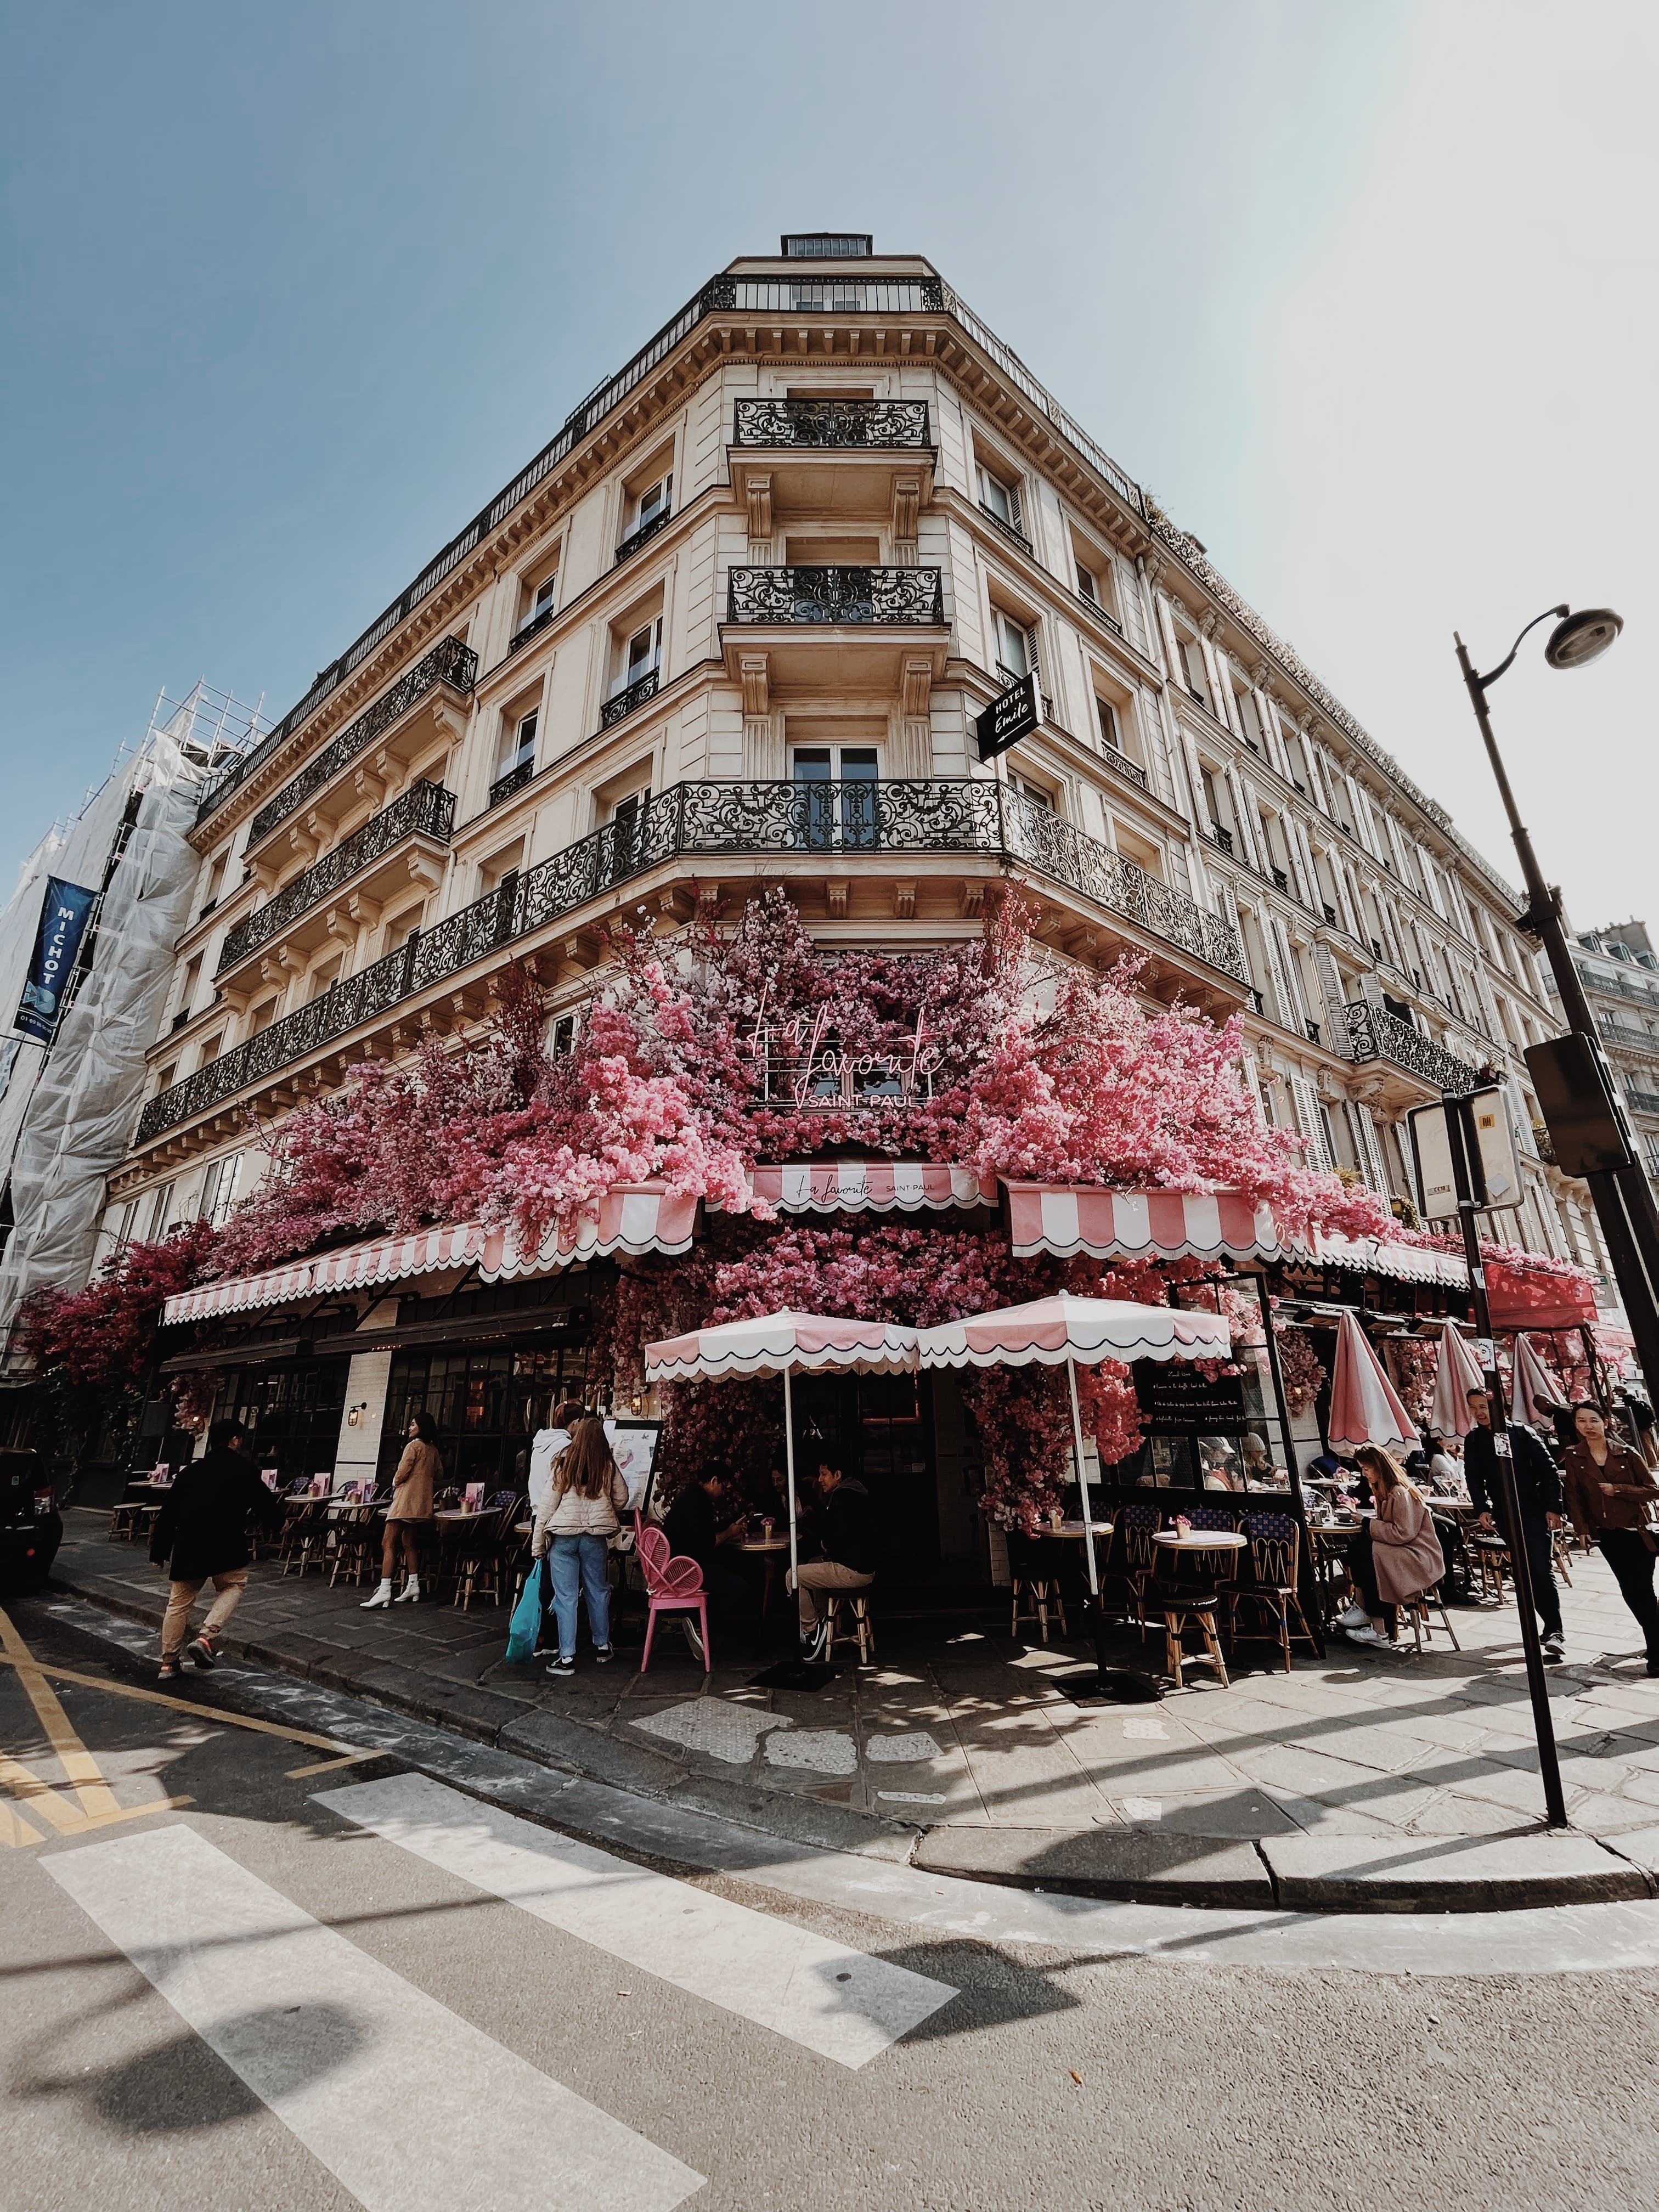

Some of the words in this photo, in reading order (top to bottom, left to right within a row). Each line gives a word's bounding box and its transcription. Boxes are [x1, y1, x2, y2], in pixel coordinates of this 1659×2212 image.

[996, 686, 1025, 714] HOTEL
[995, 702, 1028, 733] Emile
[43, 906, 74, 984] MICHOT
[746, 983, 808, 1057] La
[794, 1003, 945, 1109] favorite
[808, 1094, 919, 1108] SAINT-PAUL
[796, 1175, 819, 1198] La
[821, 1174, 873, 1203] favorite
[886, 1184, 935, 1192] SAINT-PAUL
